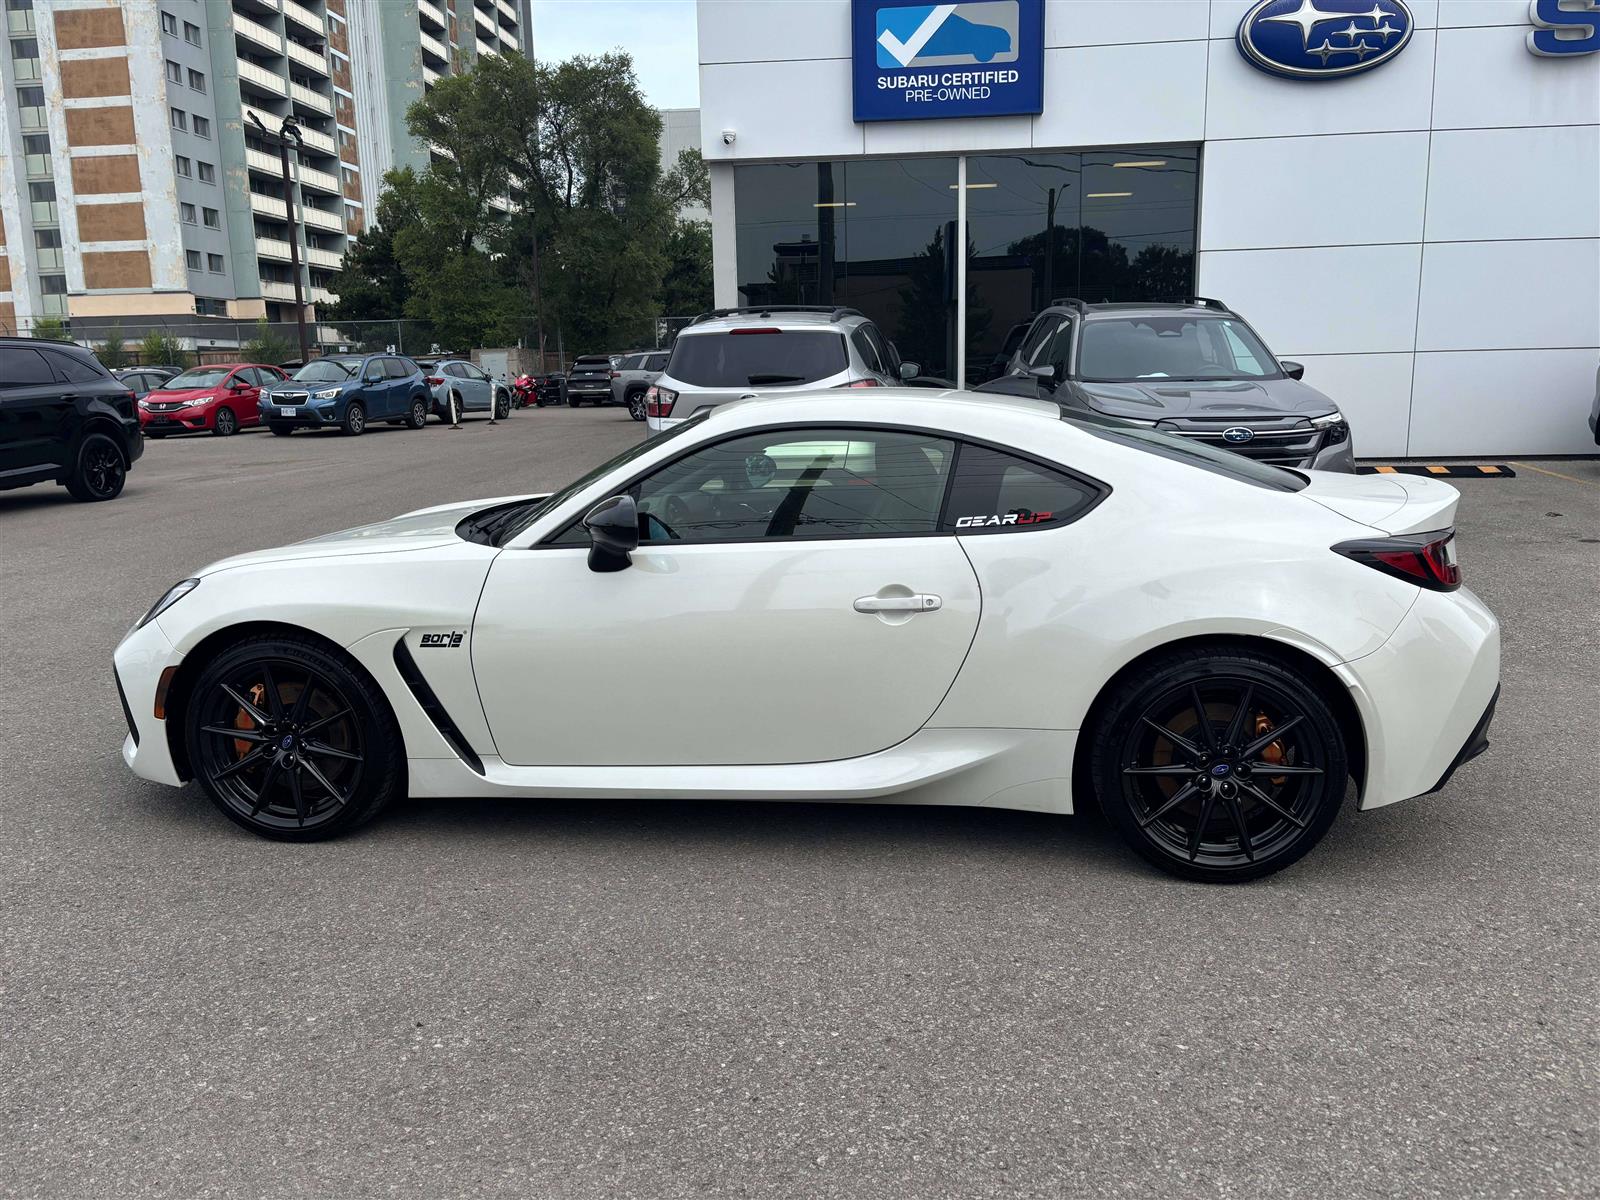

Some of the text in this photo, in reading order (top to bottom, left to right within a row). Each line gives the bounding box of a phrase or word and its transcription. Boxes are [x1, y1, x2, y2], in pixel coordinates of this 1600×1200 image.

[877, 70, 1019, 90] SUBARU CERTIFIED
[905, 86, 991, 102] PRE-OWNED
